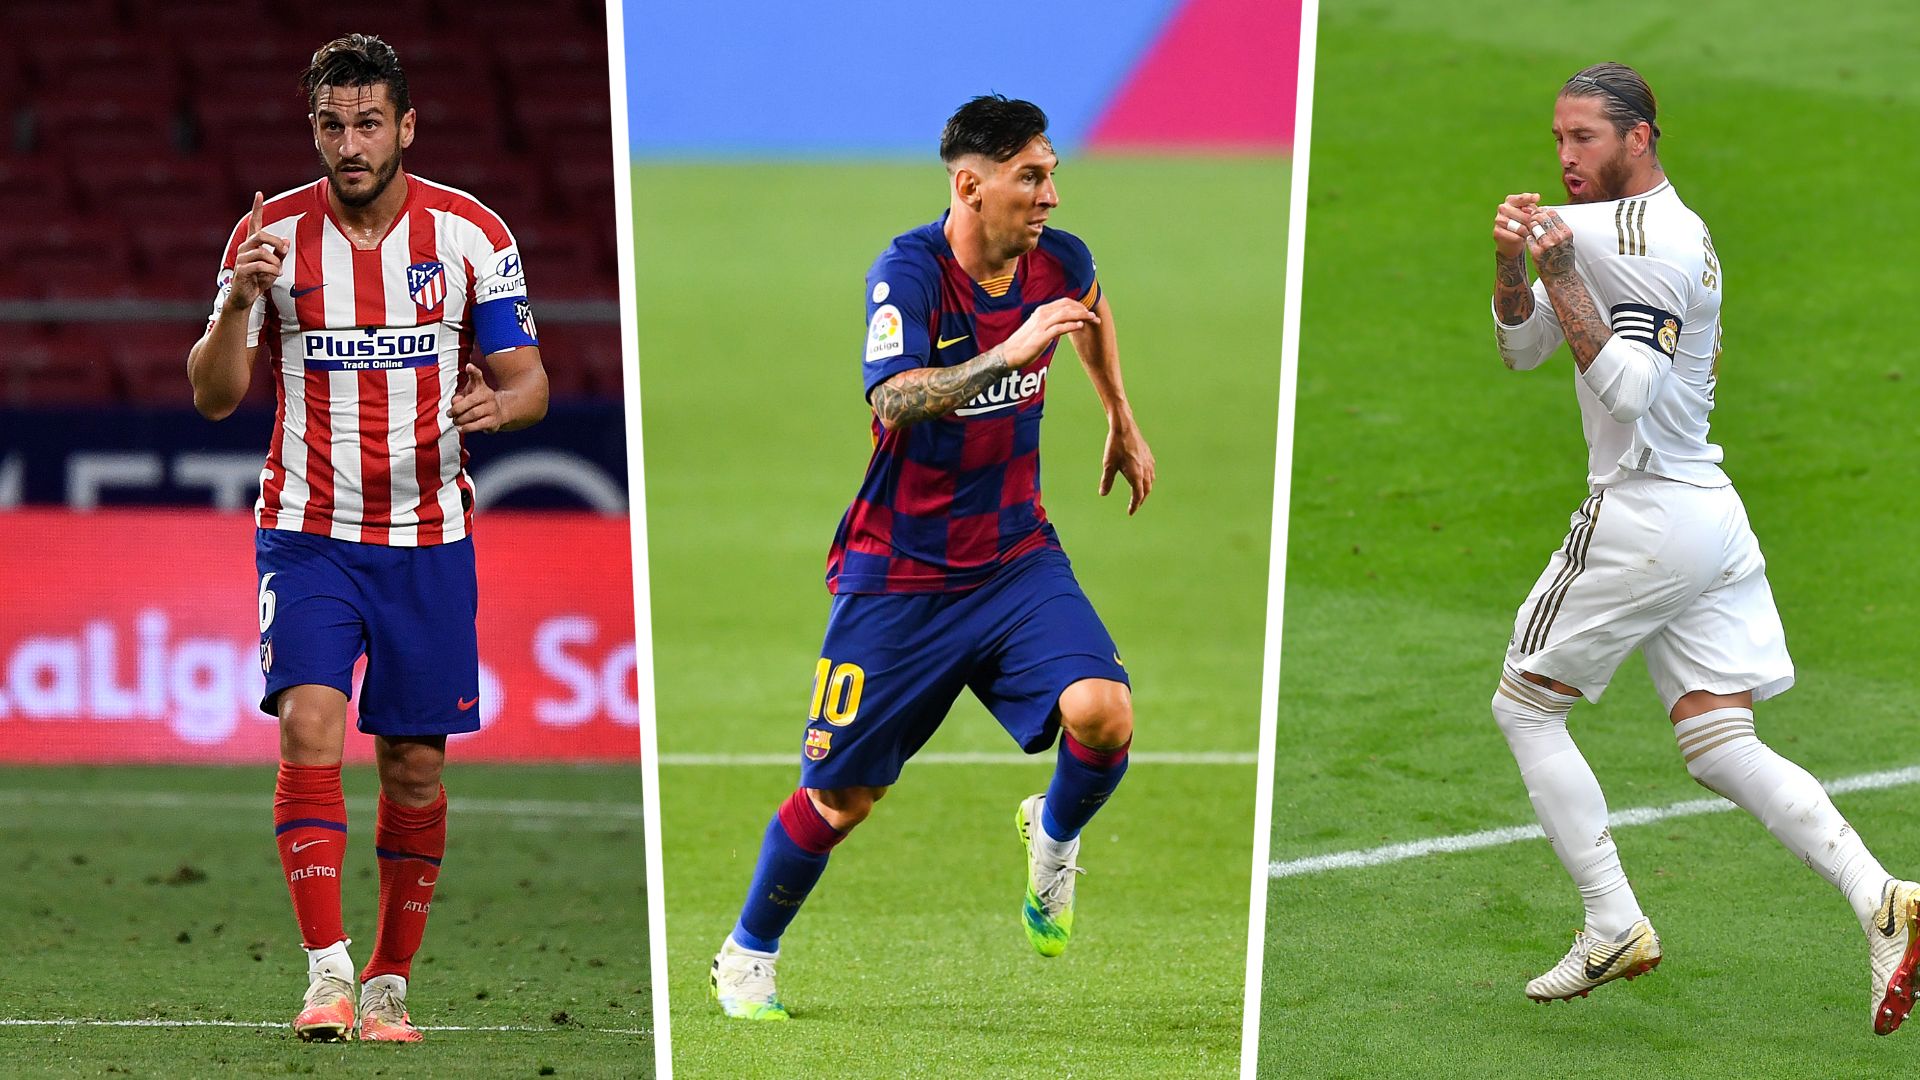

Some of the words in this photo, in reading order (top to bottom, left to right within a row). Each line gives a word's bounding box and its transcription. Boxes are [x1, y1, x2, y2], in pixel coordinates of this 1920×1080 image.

[305, 333, 436, 357] Plus500
[870, 341, 899, 354] aLiga
[342, 361, 370, 370] Trade
[372, 359, 404, 369] Online
[258, 572, 276, 634] 6
[0, 607, 279, 743] aLig
[809, 657, 865, 727] 10
[290, 864, 336, 882] ATLÉTICO
